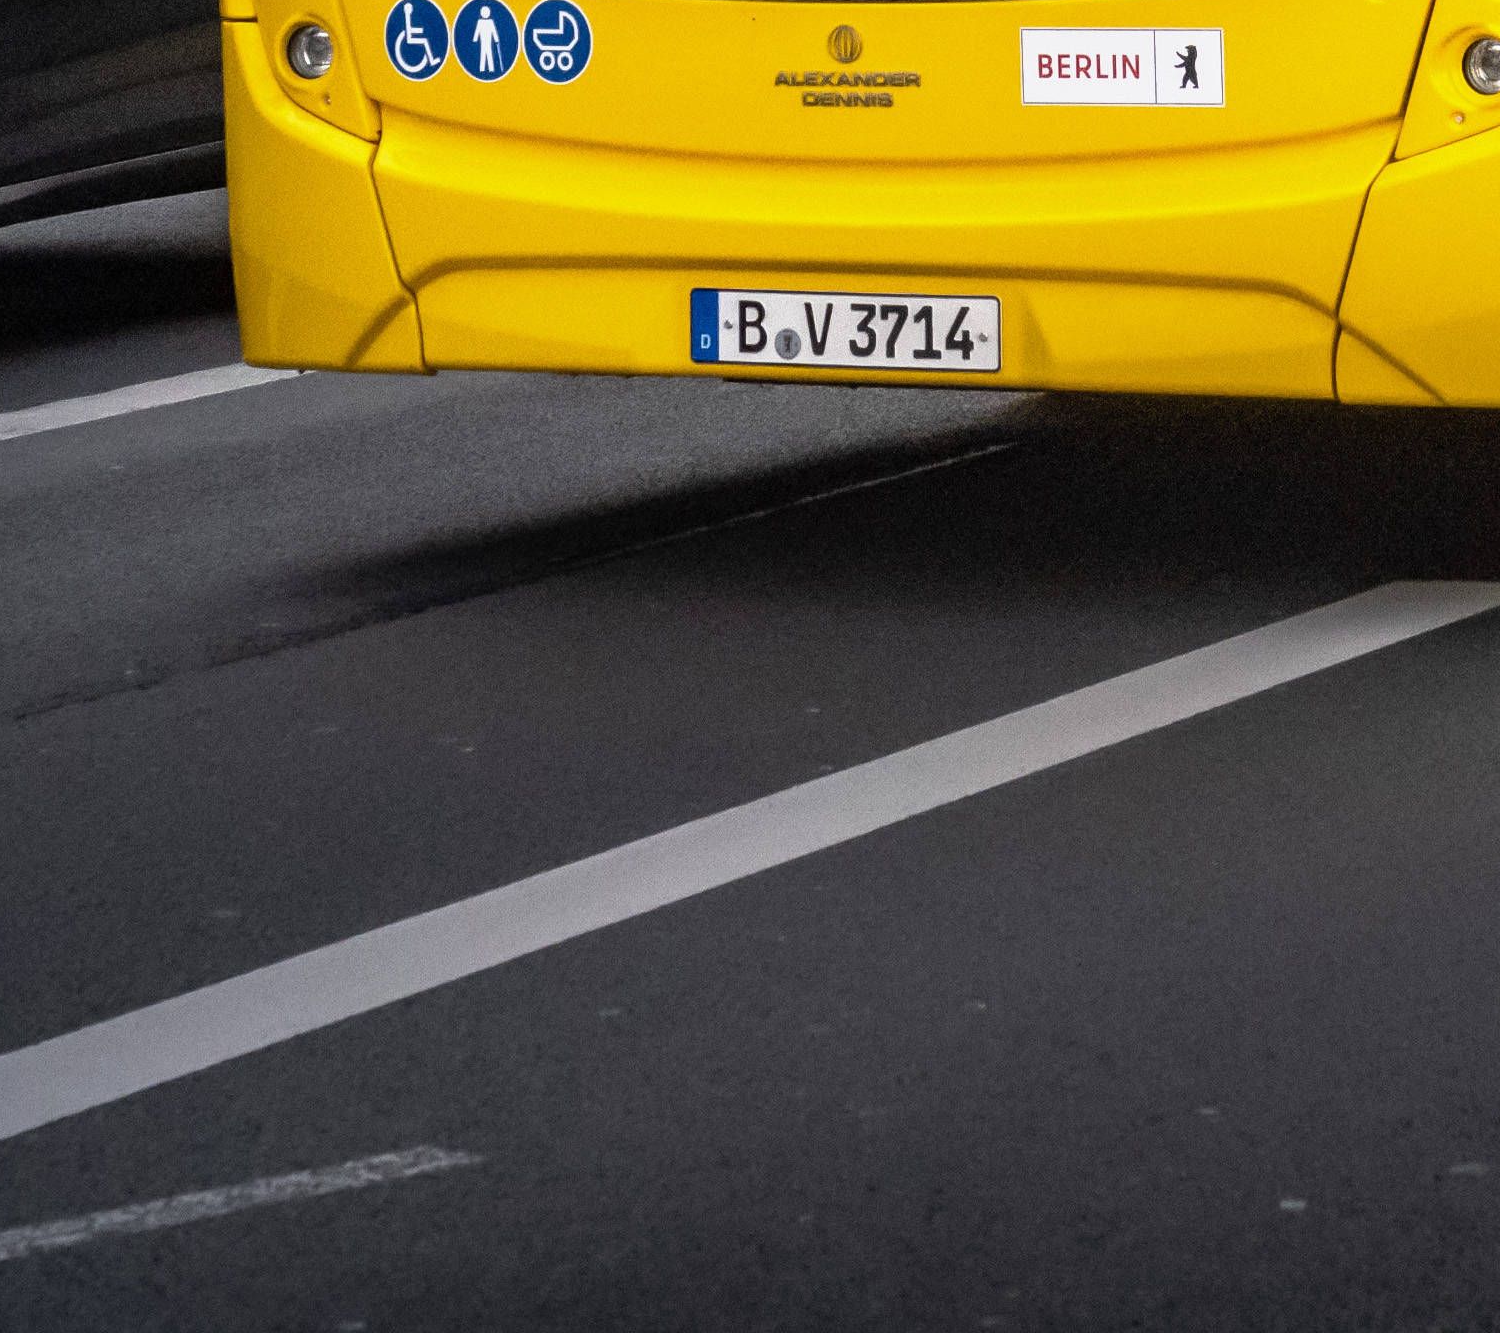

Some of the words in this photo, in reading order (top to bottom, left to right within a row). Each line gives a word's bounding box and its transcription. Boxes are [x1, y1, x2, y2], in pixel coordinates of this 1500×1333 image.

[1037, 54, 1140, 79] BERLIN
[774, 70, 921, 88] ALEXANDER
[802, 91, 893, 108] DENNIS
[700, 333, 711, 349] D
[738, 299, 768, 354] B
[804, 301, 834, 355] V
[849, 303, 975, 360] 3714
